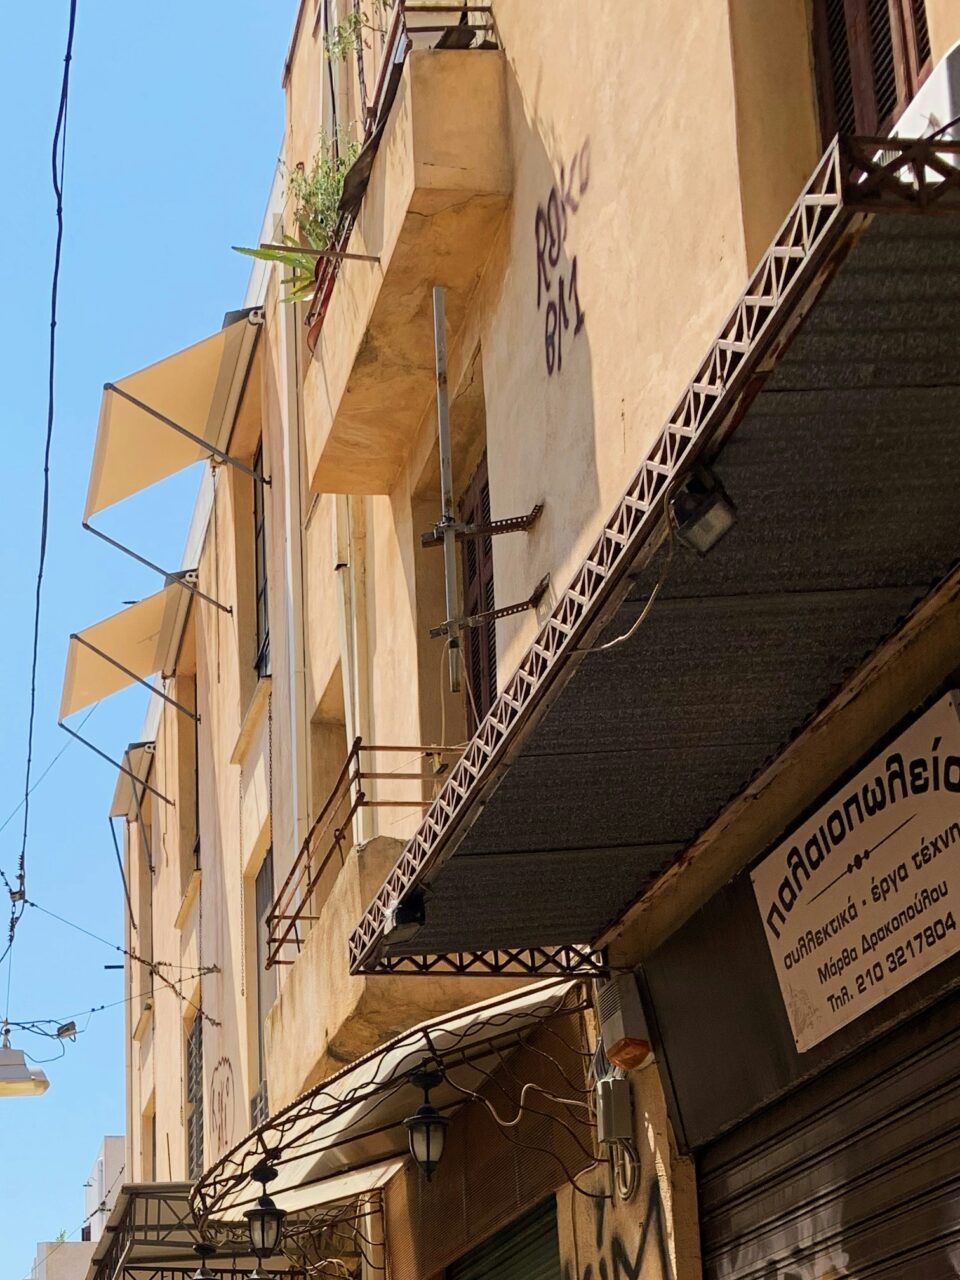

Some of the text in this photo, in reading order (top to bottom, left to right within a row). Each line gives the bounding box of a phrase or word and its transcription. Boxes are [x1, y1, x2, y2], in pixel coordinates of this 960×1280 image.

[784, 895, 859, 970] συλλεκτικά
[871, 862, 909, 903] έργα
[817, 880, 949, 985] Μάρθα Δρακοπούλου
[826, 911, 958, 1013] Τηλ. 210 3217804
